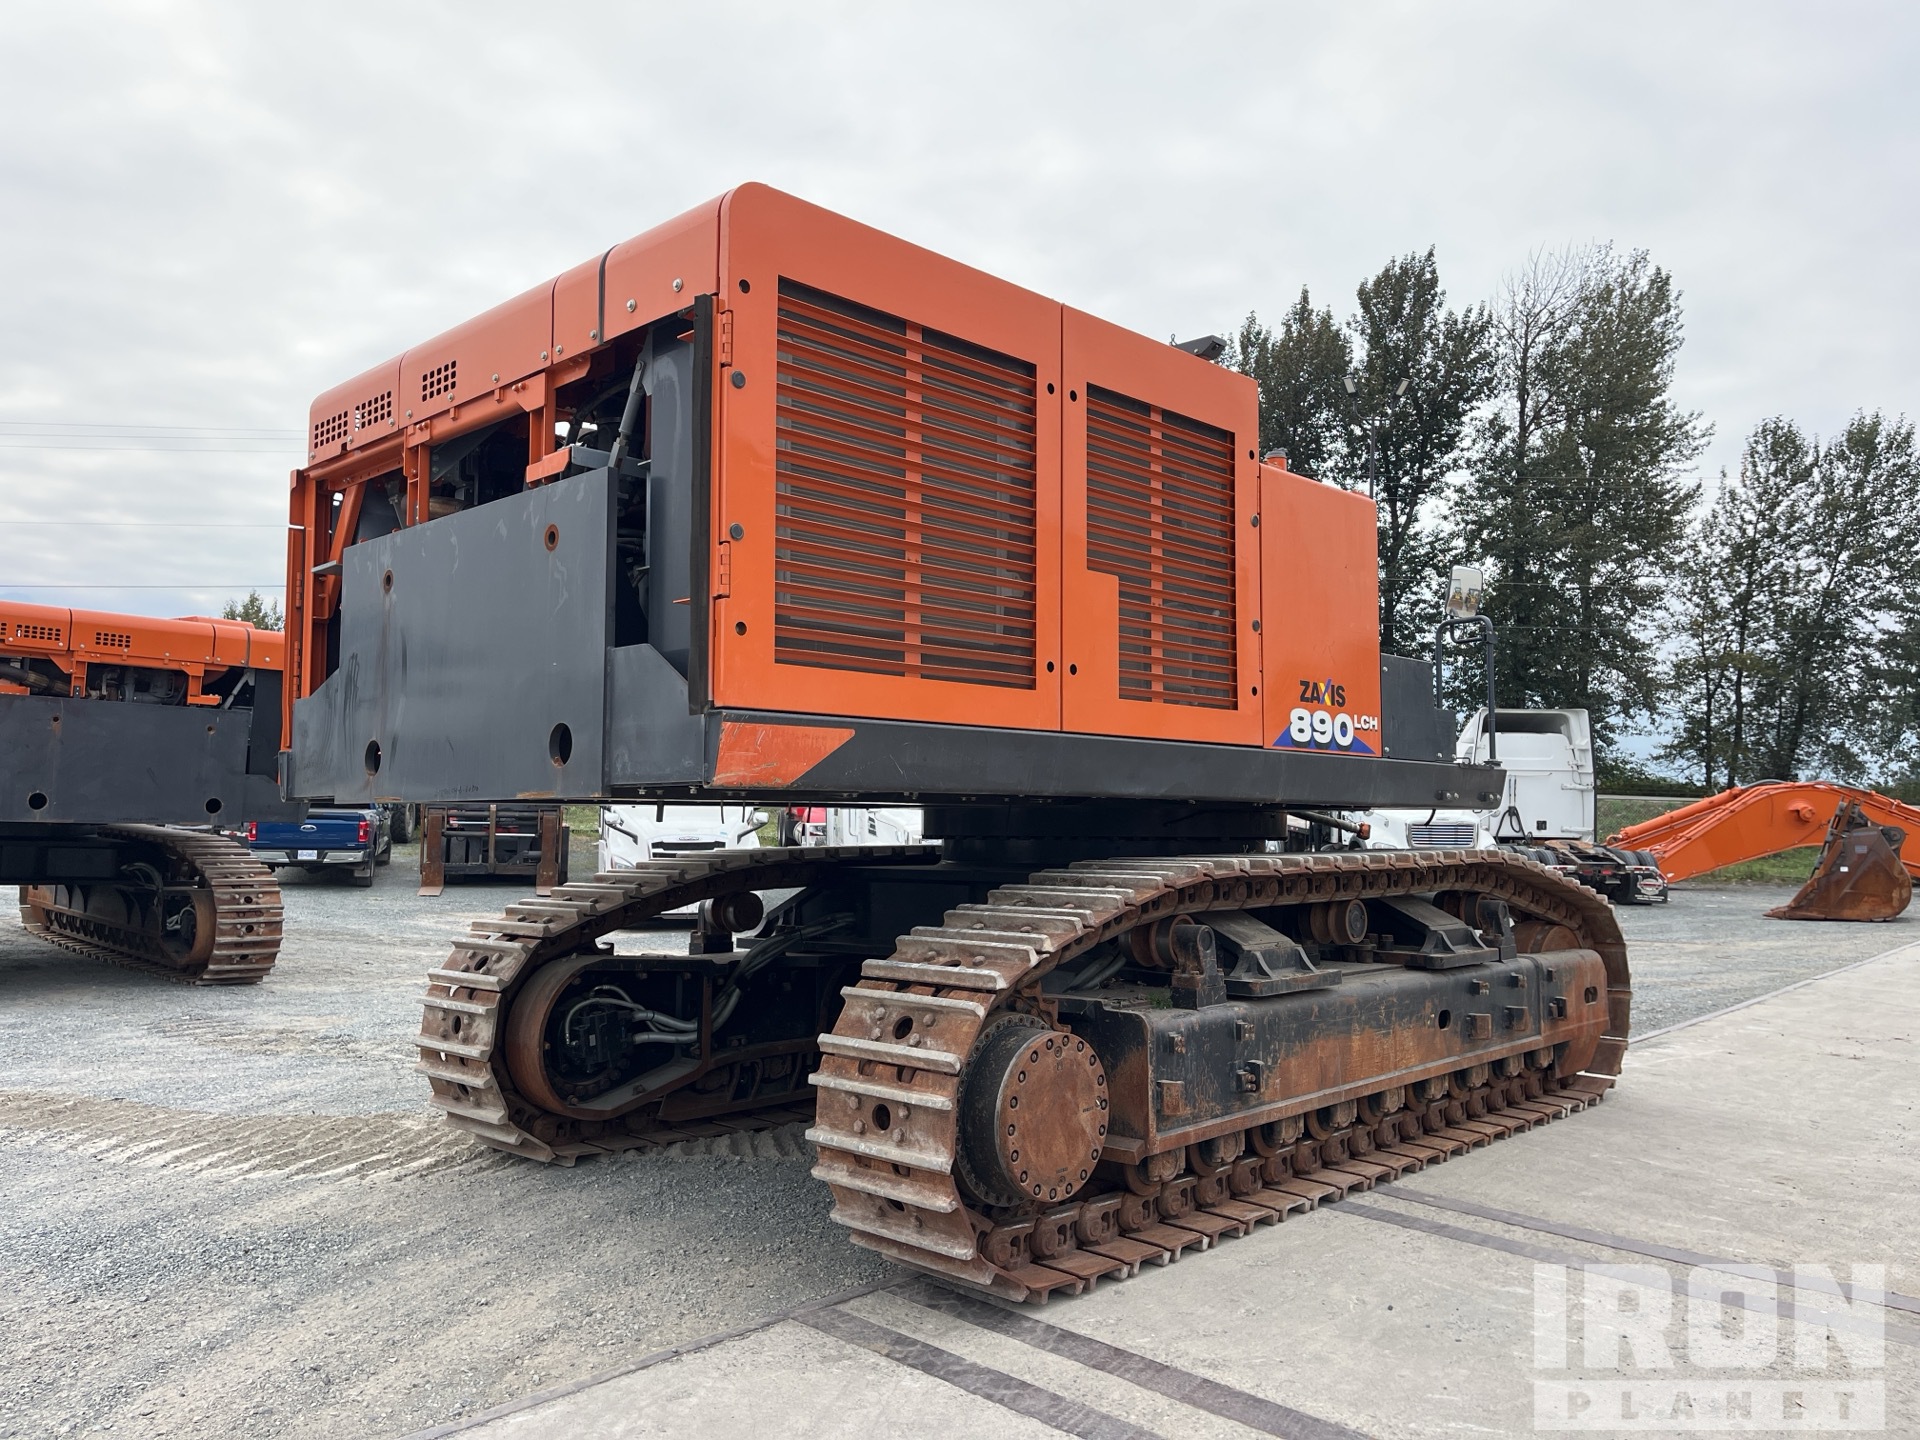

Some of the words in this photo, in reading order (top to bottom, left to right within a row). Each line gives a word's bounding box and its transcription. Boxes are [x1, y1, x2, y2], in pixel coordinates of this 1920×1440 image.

[1300, 679, 1346, 707] ZAXIS
[1290, 708, 1354, 748] 890
[1354, 714, 1378, 731] LCH
